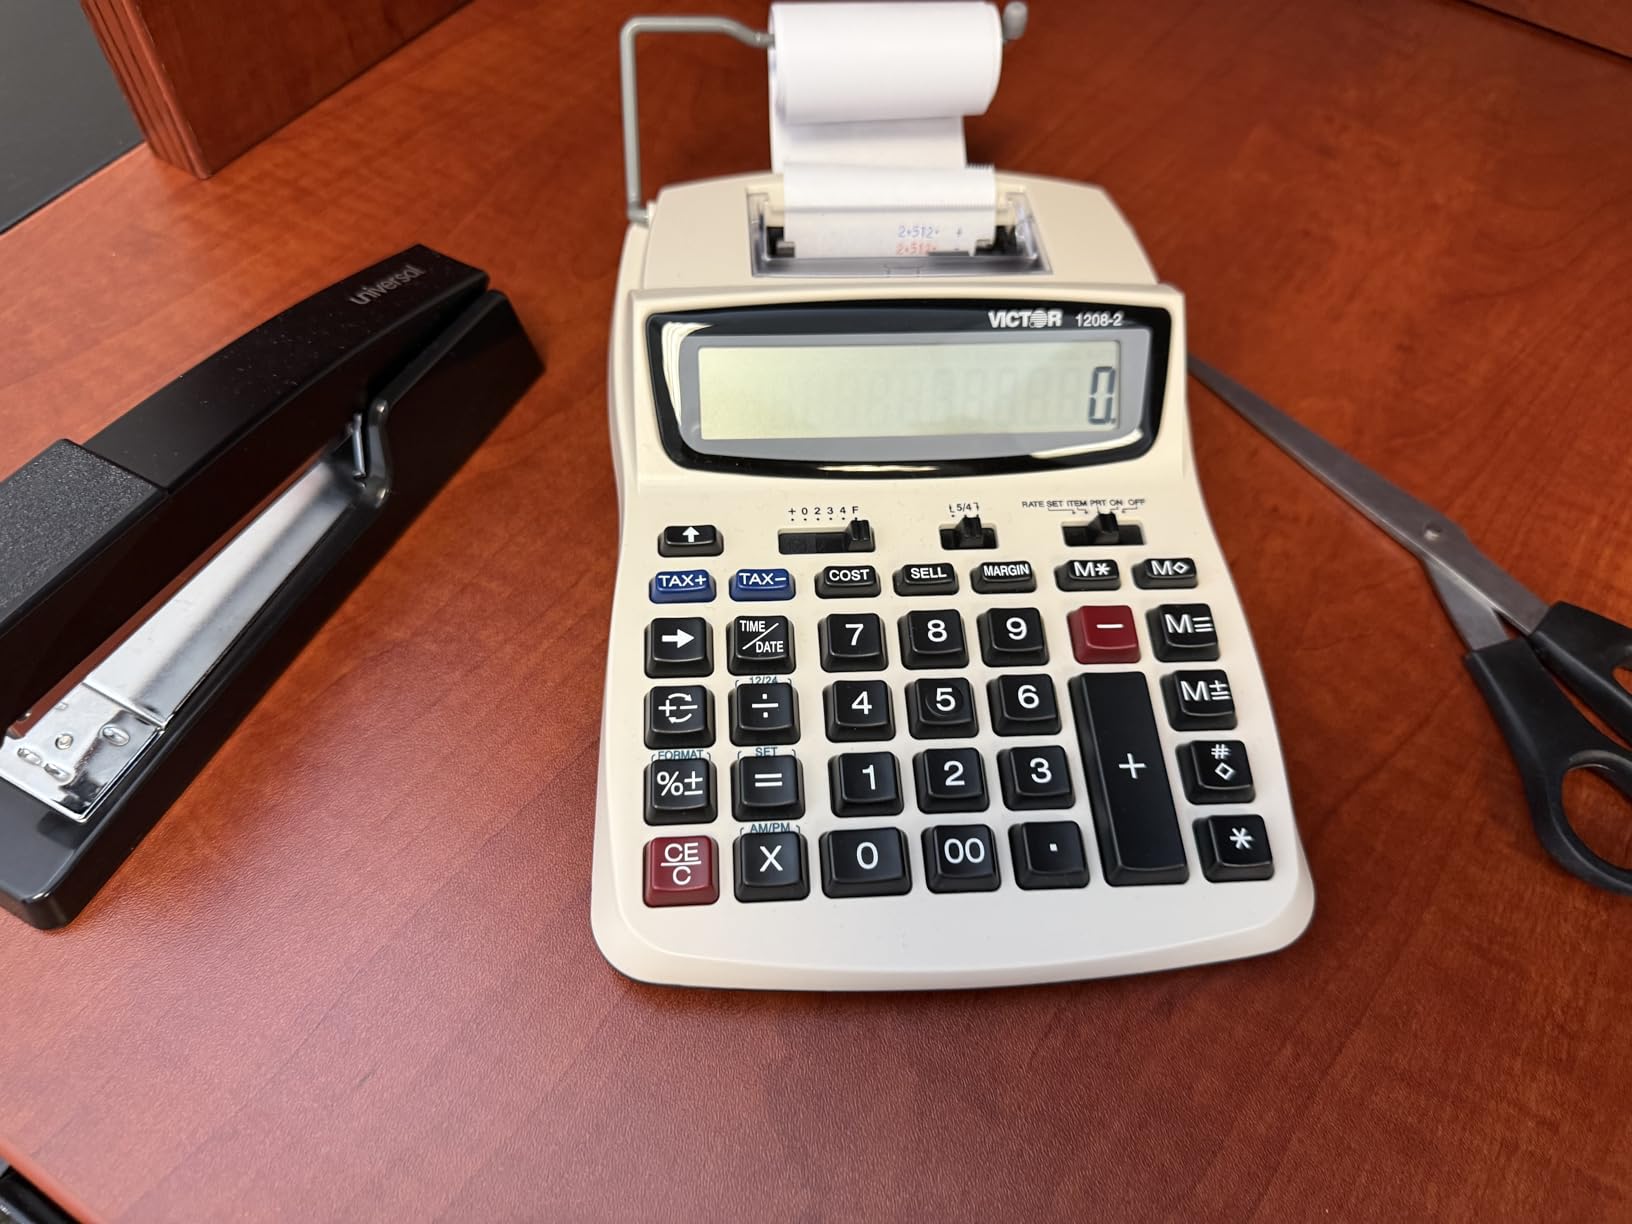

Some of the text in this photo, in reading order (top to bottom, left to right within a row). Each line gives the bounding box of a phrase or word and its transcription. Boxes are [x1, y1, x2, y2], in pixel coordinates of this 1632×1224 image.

[349, 264, 425, 305] universal
[988, 309, 1124, 328] VICTOR 1208-2
[801, 507, 808, 515] 0
[814, 507, 821, 515] 2
[827, 506, 834, 515] 3
[839, 506, 847, 514] 4
[852, 506, 859, 514] F
[658, 574, 707, 588] TAX+
[828, 569, 870, 581] COST
[910, 567, 948, 579] SELL
[983, 563, 1030, 577] MARGIN
[739, 620, 766, 633] TIME
[844, 623, 865, 646] 7
[927, 619, 949, 643] 8
[1005, 617, 1028, 641] 9
[755, 640, 784, 653] DATE
[851, 690, 873, 715] 4
[935, 687, 956, 712] 5
[1017, 684, 1040, 709] 6
[658, 750, 704, 760] FORMAT
[755, 747, 778, 757] SET
[862, 764, 877, 791] 1
[943, 761, 966, 787] 2
[1029, 757, 1053, 784] 3
[750, 822, 791, 833] AM/PM
[664, 842, 700, 863] CE
[759, 845, 784, 873] X
[856, 841, 879, 870] 0
[944, 837, 985, 864] 00
[672, 866, 692, 886] C
